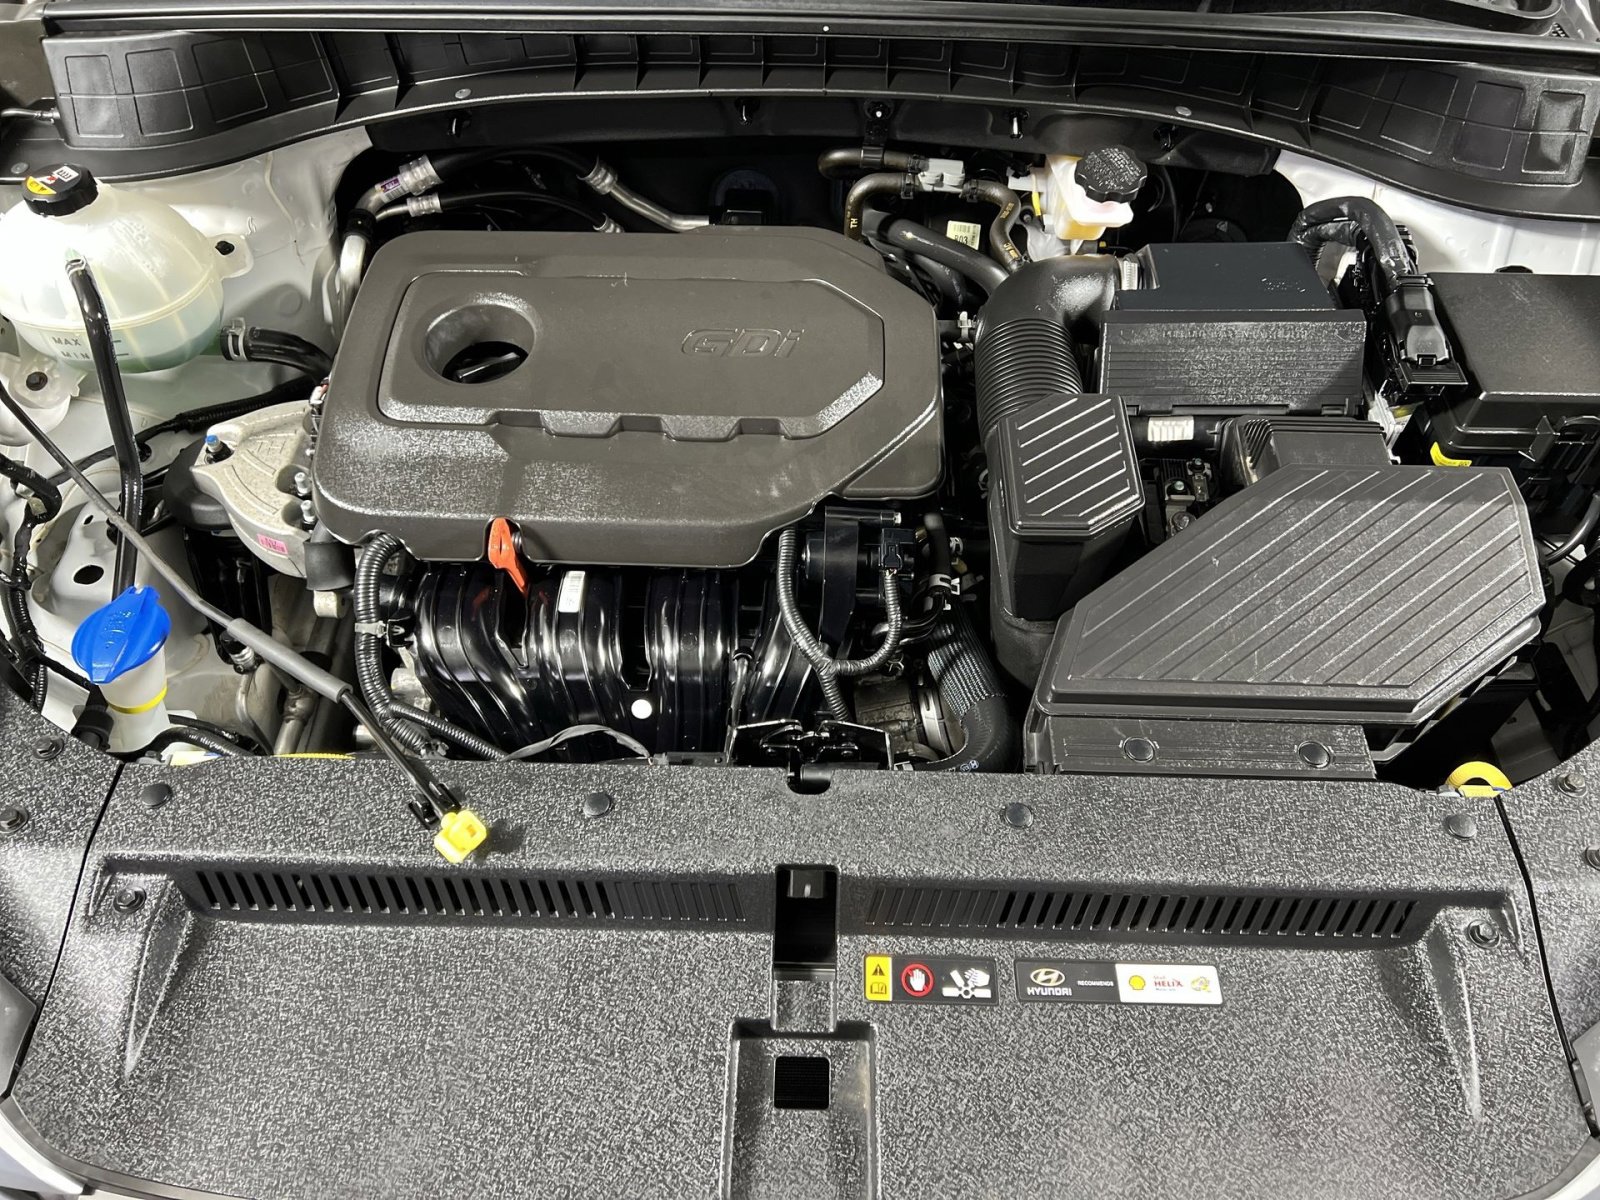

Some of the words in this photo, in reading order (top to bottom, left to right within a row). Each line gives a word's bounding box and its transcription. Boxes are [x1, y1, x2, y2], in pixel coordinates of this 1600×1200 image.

[850, 218, 858, 229] TH
[52, 336, 81, 346] MAX
[681, 328, 805, 358] GDi
[61, 350, 90, 360] MIN
[1154, 978, 1183, 987] HELIX
[1026, 986, 1072, 996] HYUNDAI
